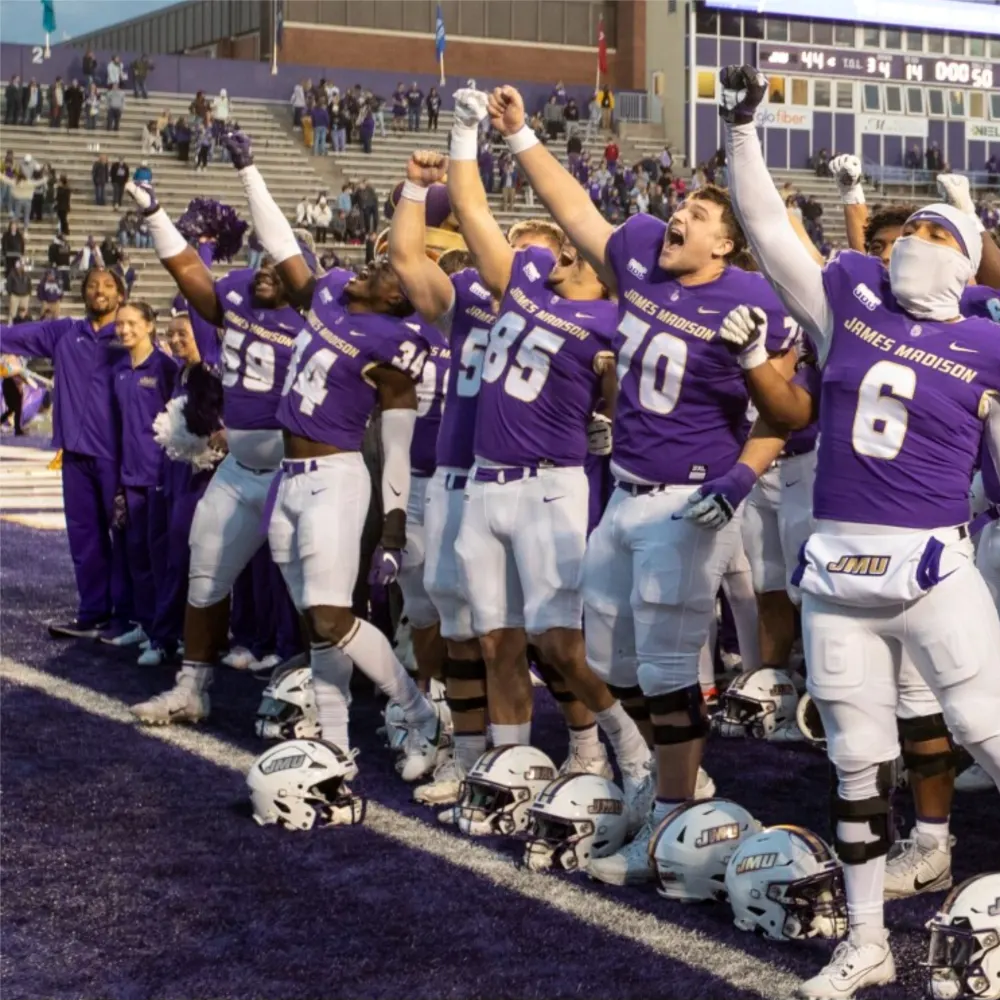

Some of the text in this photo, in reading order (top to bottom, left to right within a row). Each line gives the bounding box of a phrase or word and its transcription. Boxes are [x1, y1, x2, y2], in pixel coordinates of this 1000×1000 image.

[465, 304, 498, 326] JAME
[534, 308, 591, 342] MADISON
[624, 288, 717, 342] JAMES MADISON
[780, 315, 804, 351] 7
[221, 327, 276, 393] 59
[390, 339, 429, 380] 34
[481, 310, 567, 404] 85
[616, 310, 689, 416] 70
[843, 316, 979, 384] JAMES MADISON
[852, 359, 917, 461] 6
[826, 554, 892, 577] JMU
[263, 753, 307, 776] JMU
[694, 822, 740, 849] JMU
[735, 852, 779, 876] JMU
